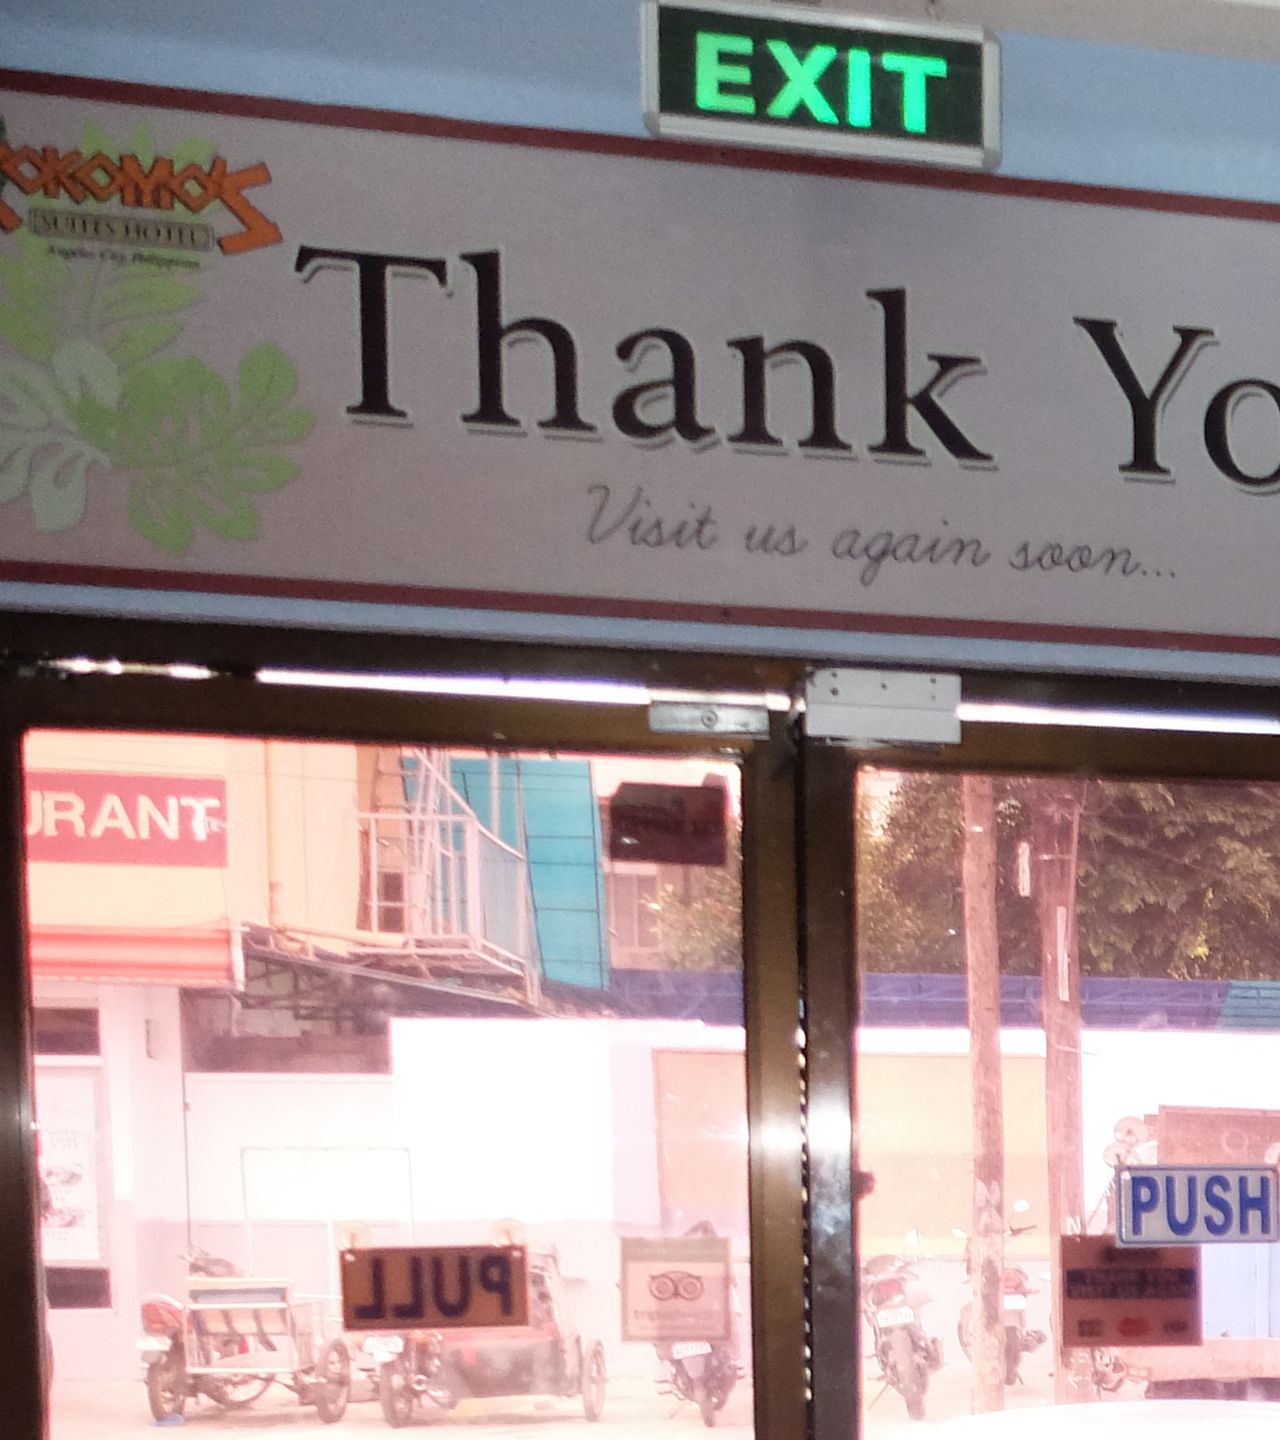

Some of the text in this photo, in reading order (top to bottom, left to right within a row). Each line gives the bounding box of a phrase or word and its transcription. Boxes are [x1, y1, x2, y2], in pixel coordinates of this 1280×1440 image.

[695, 31, 948, 134] EXIT
[295, 245, 996, 468] Thank
[586, 485, 1177, 586] Visit us again soon...
[1131, 1175, 1271, 1237] PUSH
